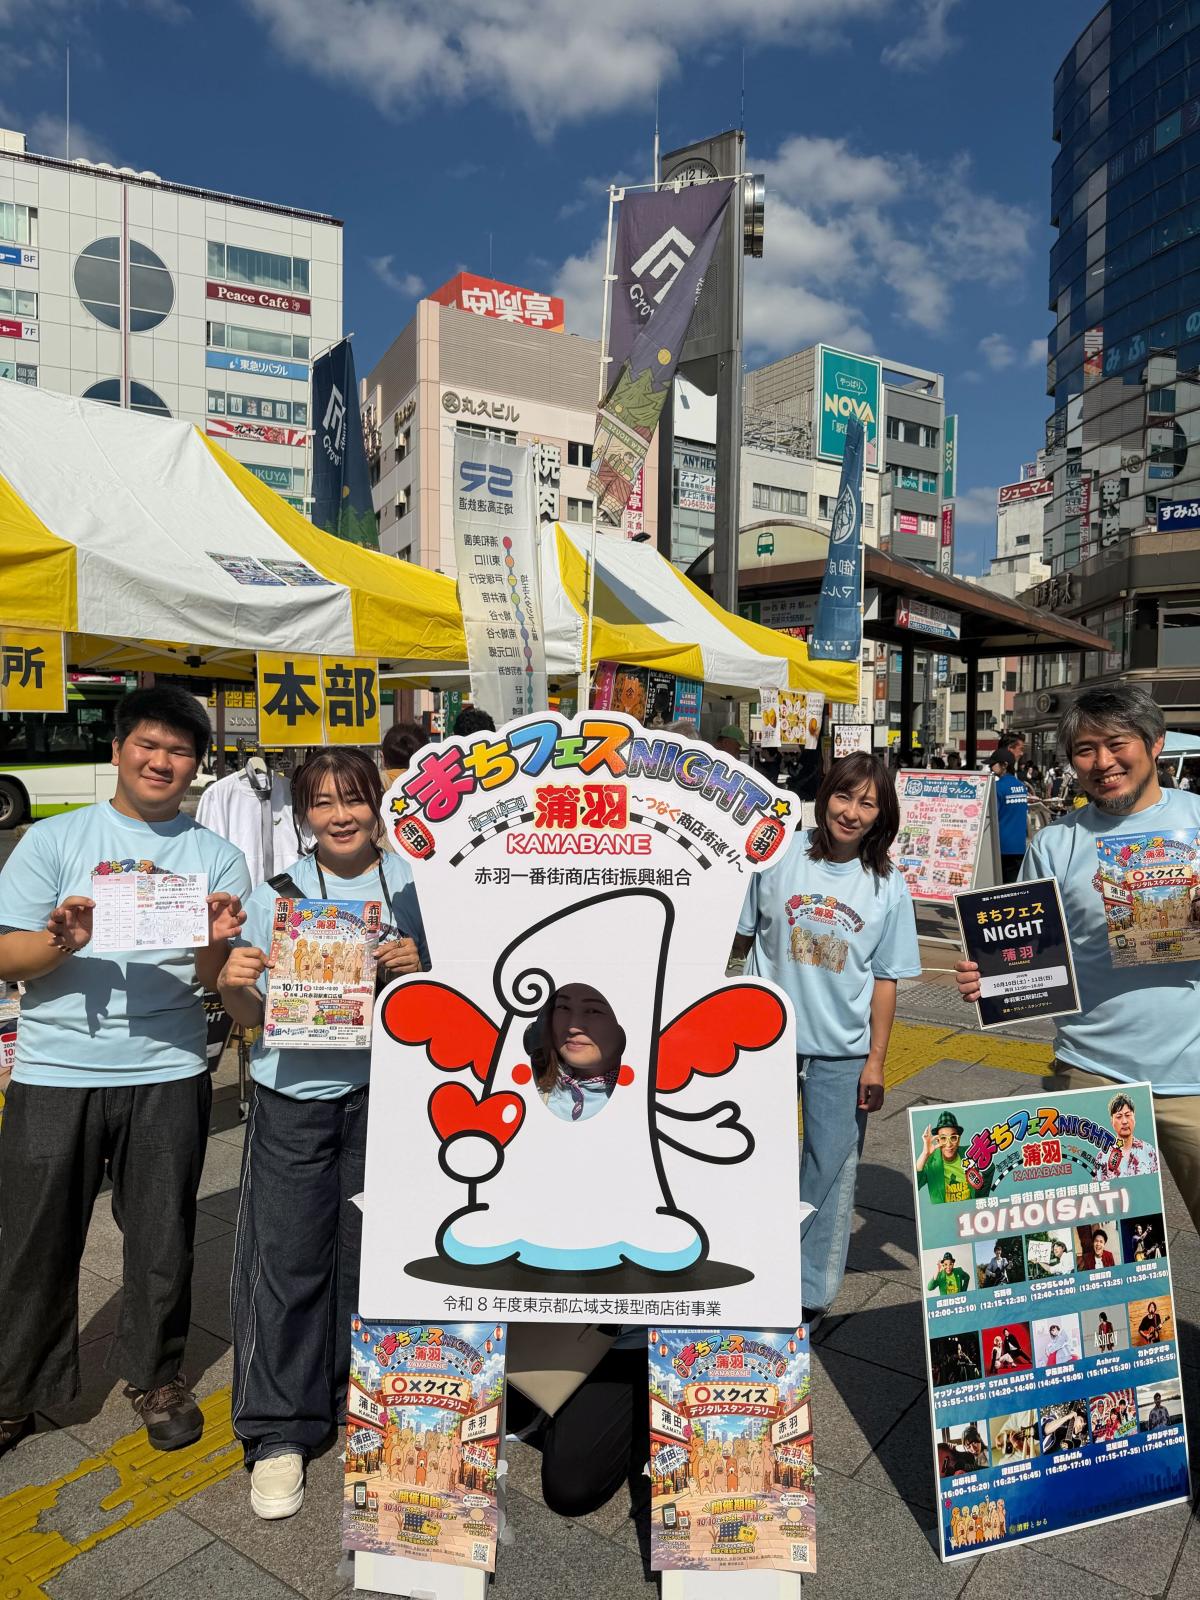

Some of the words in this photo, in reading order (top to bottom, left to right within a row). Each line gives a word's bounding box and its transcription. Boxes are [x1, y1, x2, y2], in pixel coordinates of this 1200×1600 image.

[23, 255, 36, 263] 8F
[217, 286, 256, 303] Peace
[258, 294, 289, 309] Café
[462, 287, 554, 326] 安楽亭
[24, 327, 37, 336] 7F
[240, 359, 289, 376] 東急リバブル
[461, 396, 520, 423] 丸久ビル
[824, 392, 875, 423] NOVA
[0, 646, 46, 689] 所
[263, 661, 377, 727] 本部
[534, 784, 628, 830] 蒲羽
[401, 822, 429, 852] 蒲田
[506, 833, 652, 855] KAMABANE
[752, 824, 779, 856] 赤羽
[474, 866, 692, 886] 赤羽一番街商店街振興組合
[277, 901, 289, 923] 蒲田
[368, 904, 380, 927] 赤羽
[976, 902, 1045, 925] まちフェス
[982, 919, 1044, 943] NIGHT
[1002, 945, 1034, 962] 蒲羽
[281, 983, 303, 992] 10/11
[1022, 1140, 1063, 1168] 蒲羽
[1013, 1164, 1073, 1182] KAMABANE
[959, 1188, 1129, 1238] 10/10(SAT)
[928, 1303, 977, 1319] (12:00-12:10)
[414, 1346, 442, 1362] 蒲羽
[715, 1354, 745, 1370] 蒲羽
[1096, 1356, 1120, 1367] Ashray
[358, 1395, 379, 1416] 蒲田
[385, 1394, 468, 1411] デジタルスタンプラリー
[689, 1402, 776, 1416] デジタルスタンプラリー
[468, 1414, 487, 1431] 赤羽
[661, 1409, 682, 1429] 蒲田
[778, 1415, 798, 1433] 赤羽
